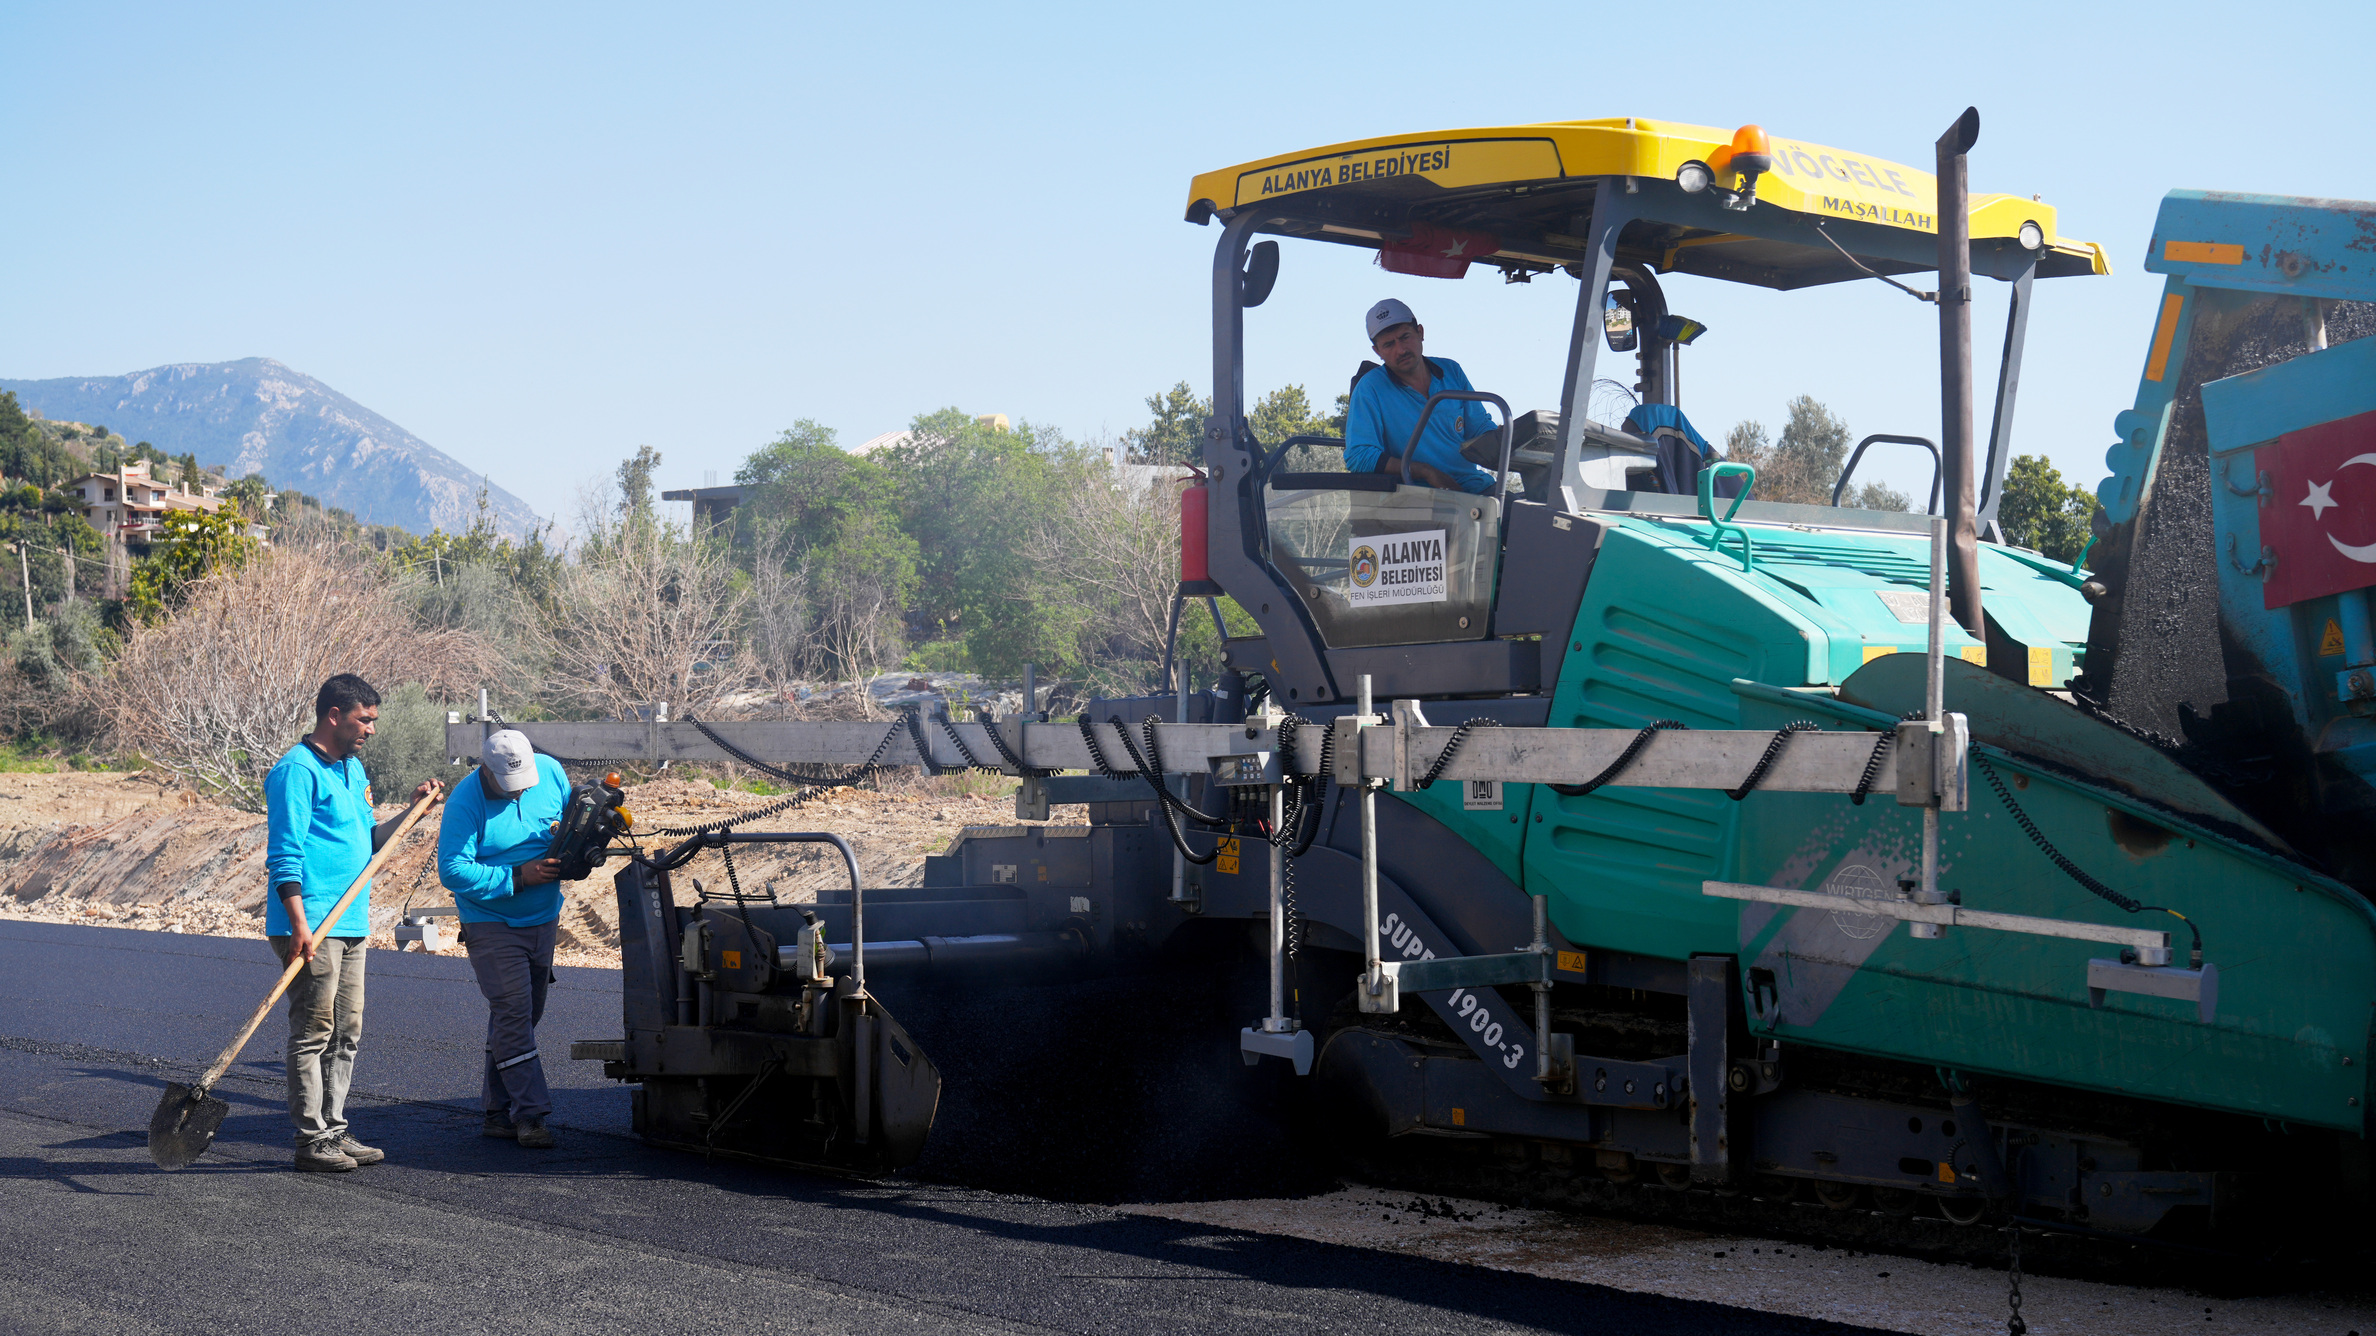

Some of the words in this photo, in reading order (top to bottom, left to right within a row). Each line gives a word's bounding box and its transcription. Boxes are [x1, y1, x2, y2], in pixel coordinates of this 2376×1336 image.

[1261, 167, 1333, 195] ALANYA
[1338, 145, 1450, 184] BELEDİYESİ
[1770, 145, 1917, 199] VÖGELE
[1823, 195, 1931, 229] MAŞALLAH
[1381, 539, 1442, 565] ALANYA
[1381, 563, 1443, 586] BELEDİYESİ
[1350, 592, 1365, 600] FEN
[1366, 588, 1390, 600] İŞLERİ
[1392, 585, 1444, 597] MÜDÜRLÜĞÜ
[1472, 780, 1493, 799] DMO
[1826, 883, 1895, 901] WIRTGEN
[1447, 988, 1524, 1069] 1900-3
